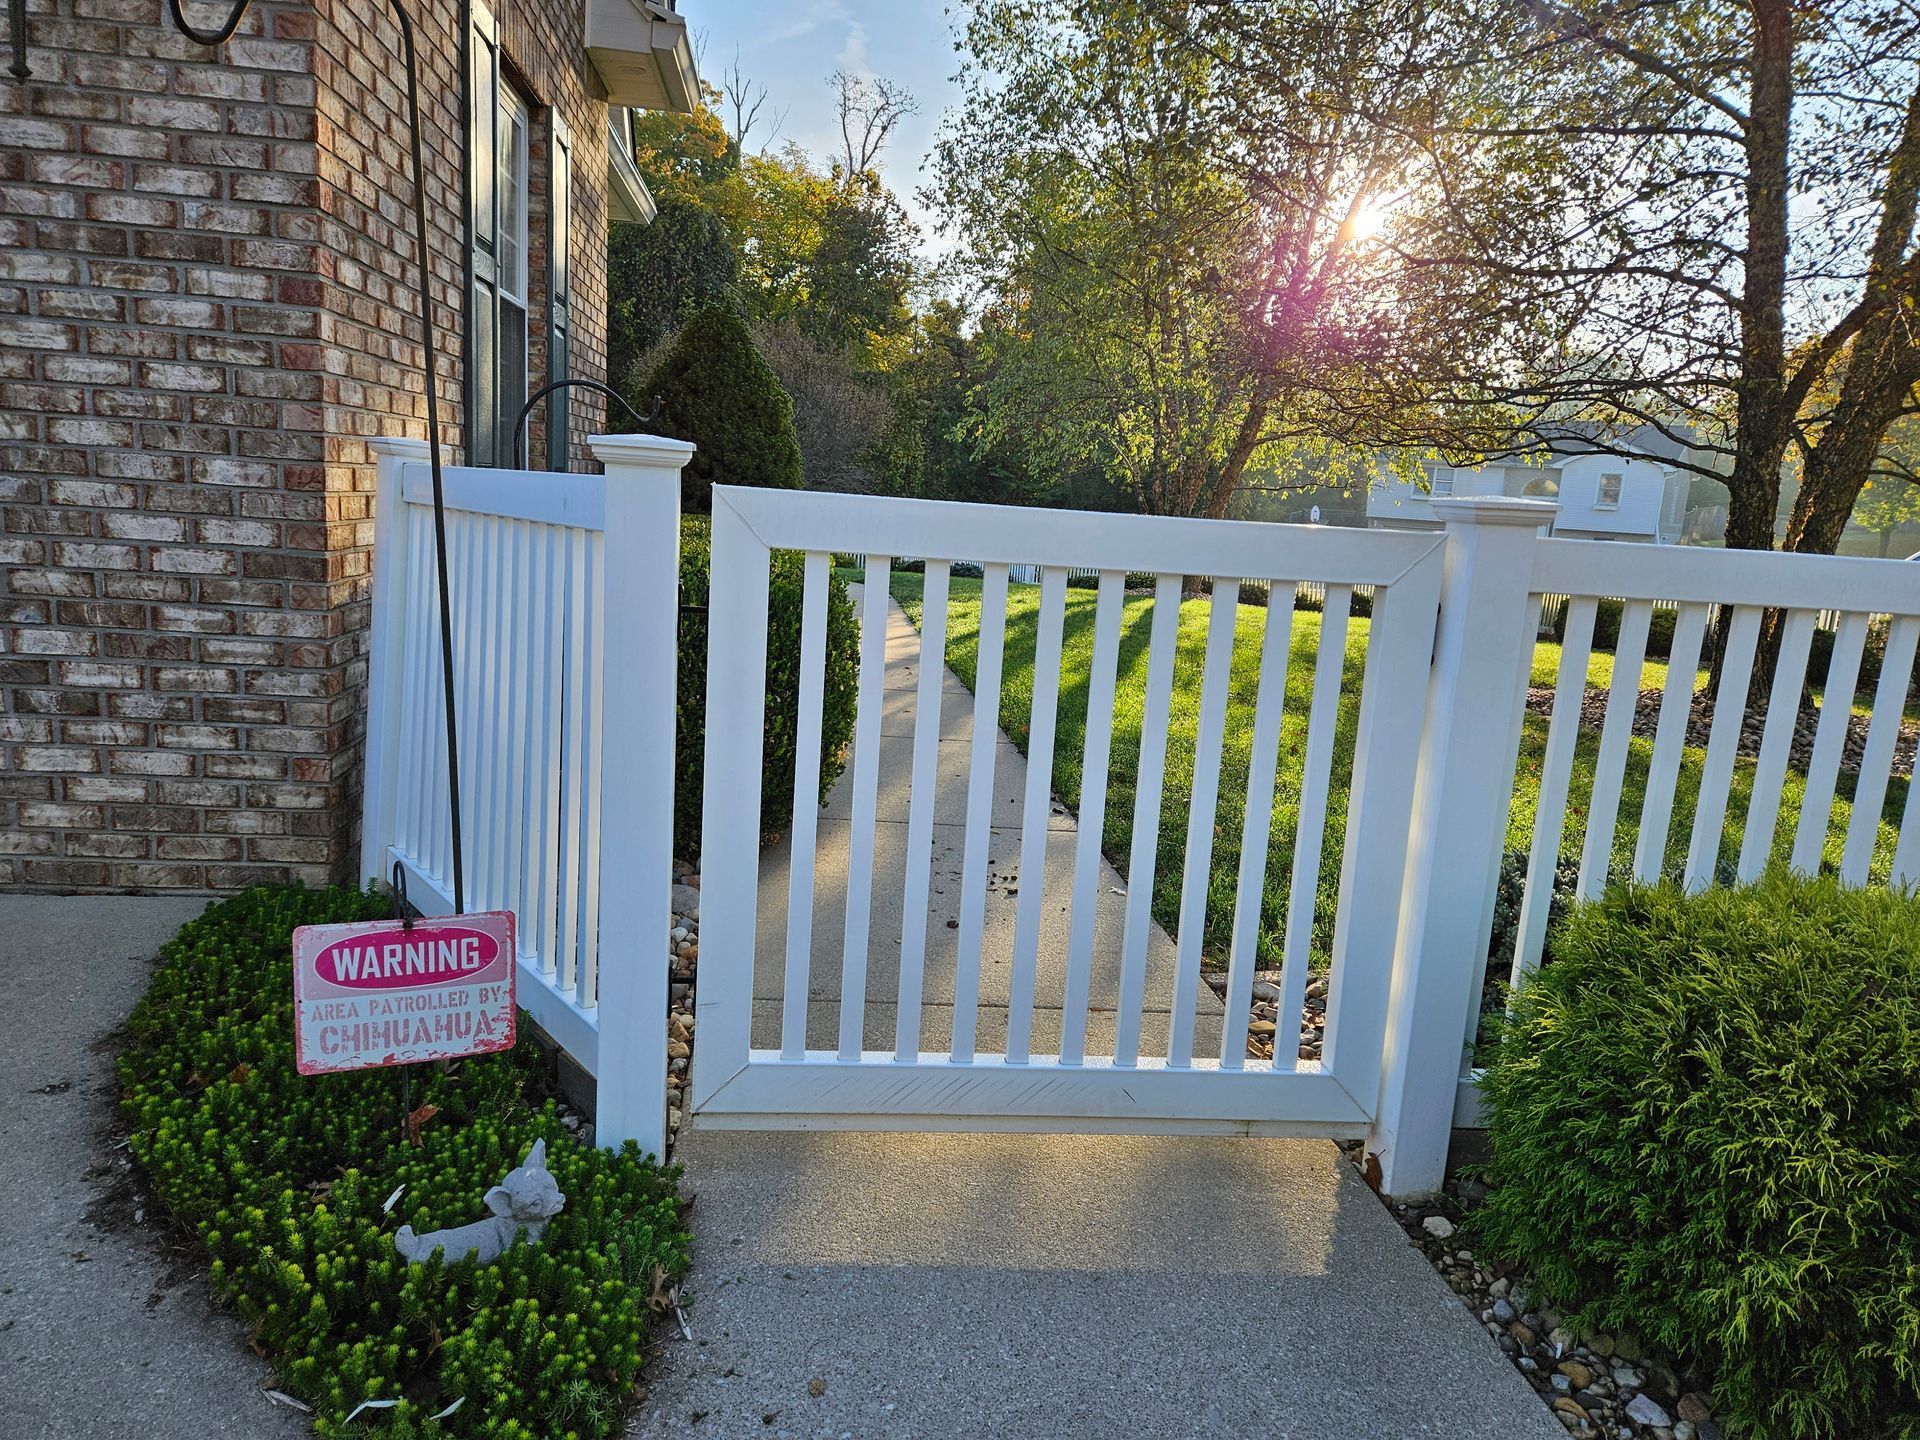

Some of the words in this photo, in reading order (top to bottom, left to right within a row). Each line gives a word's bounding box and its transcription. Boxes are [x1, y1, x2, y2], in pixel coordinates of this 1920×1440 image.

[332, 937, 480, 981] WARNING
[311, 1002, 359, 1022] AREA
[369, 990, 469, 1016] PATROLLED
[480, 985, 501, 1004] BY
[319, 1009, 495, 1055] CHIHUAHUA
